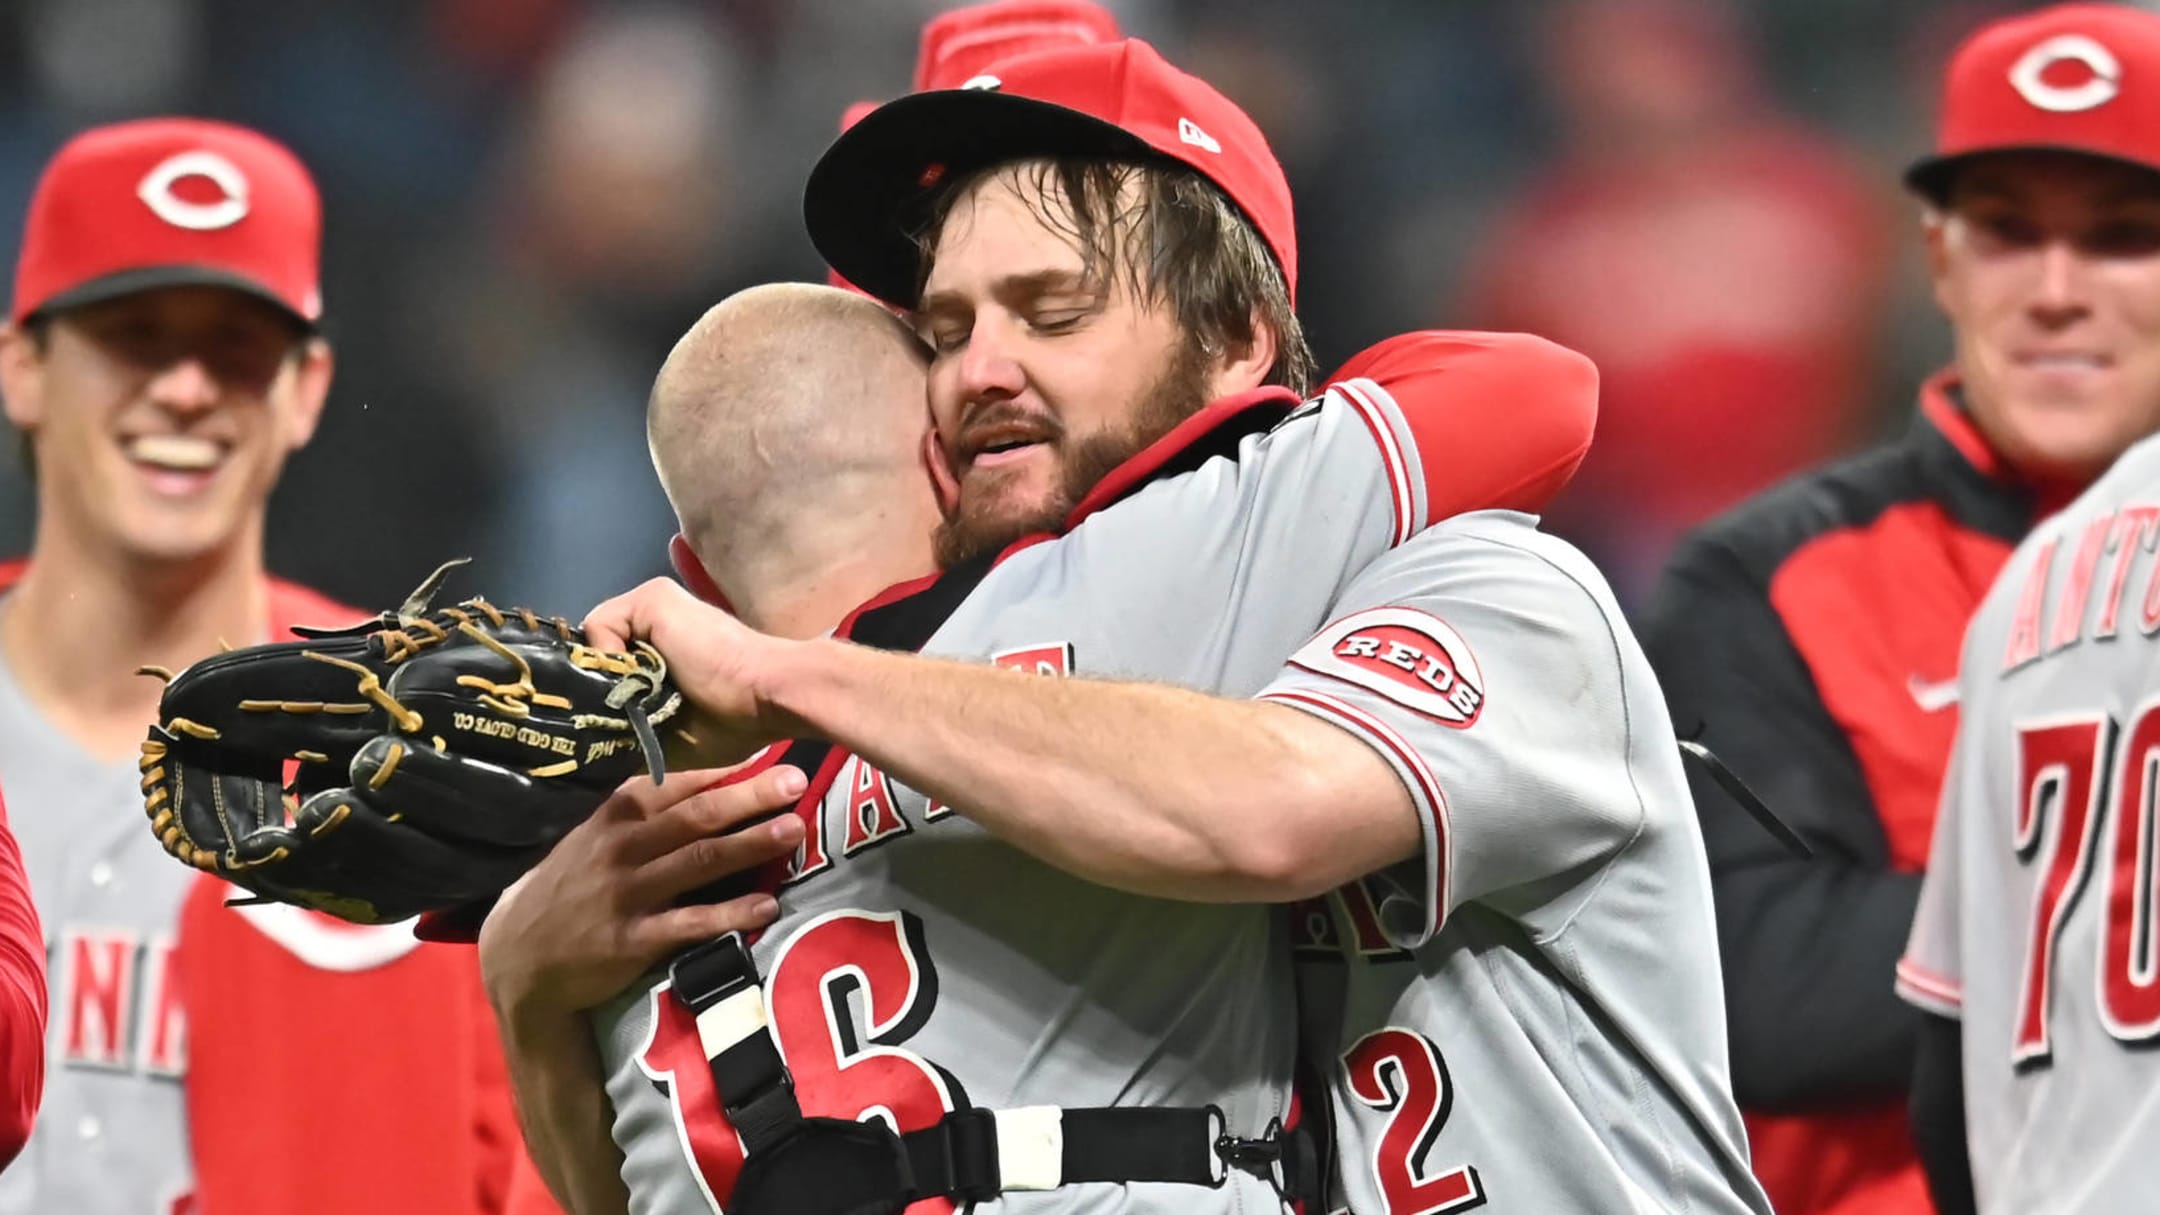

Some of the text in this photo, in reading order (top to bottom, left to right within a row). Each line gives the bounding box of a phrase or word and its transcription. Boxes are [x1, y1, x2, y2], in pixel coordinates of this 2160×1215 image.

[1338, 636, 1481, 718] REDS
[475, 718, 517, 740] GLOVE
[517, 728, 550, 749] GOLD
[2013, 697, 2160, 1075] 70
[633, 907, 973, 1215] 16
